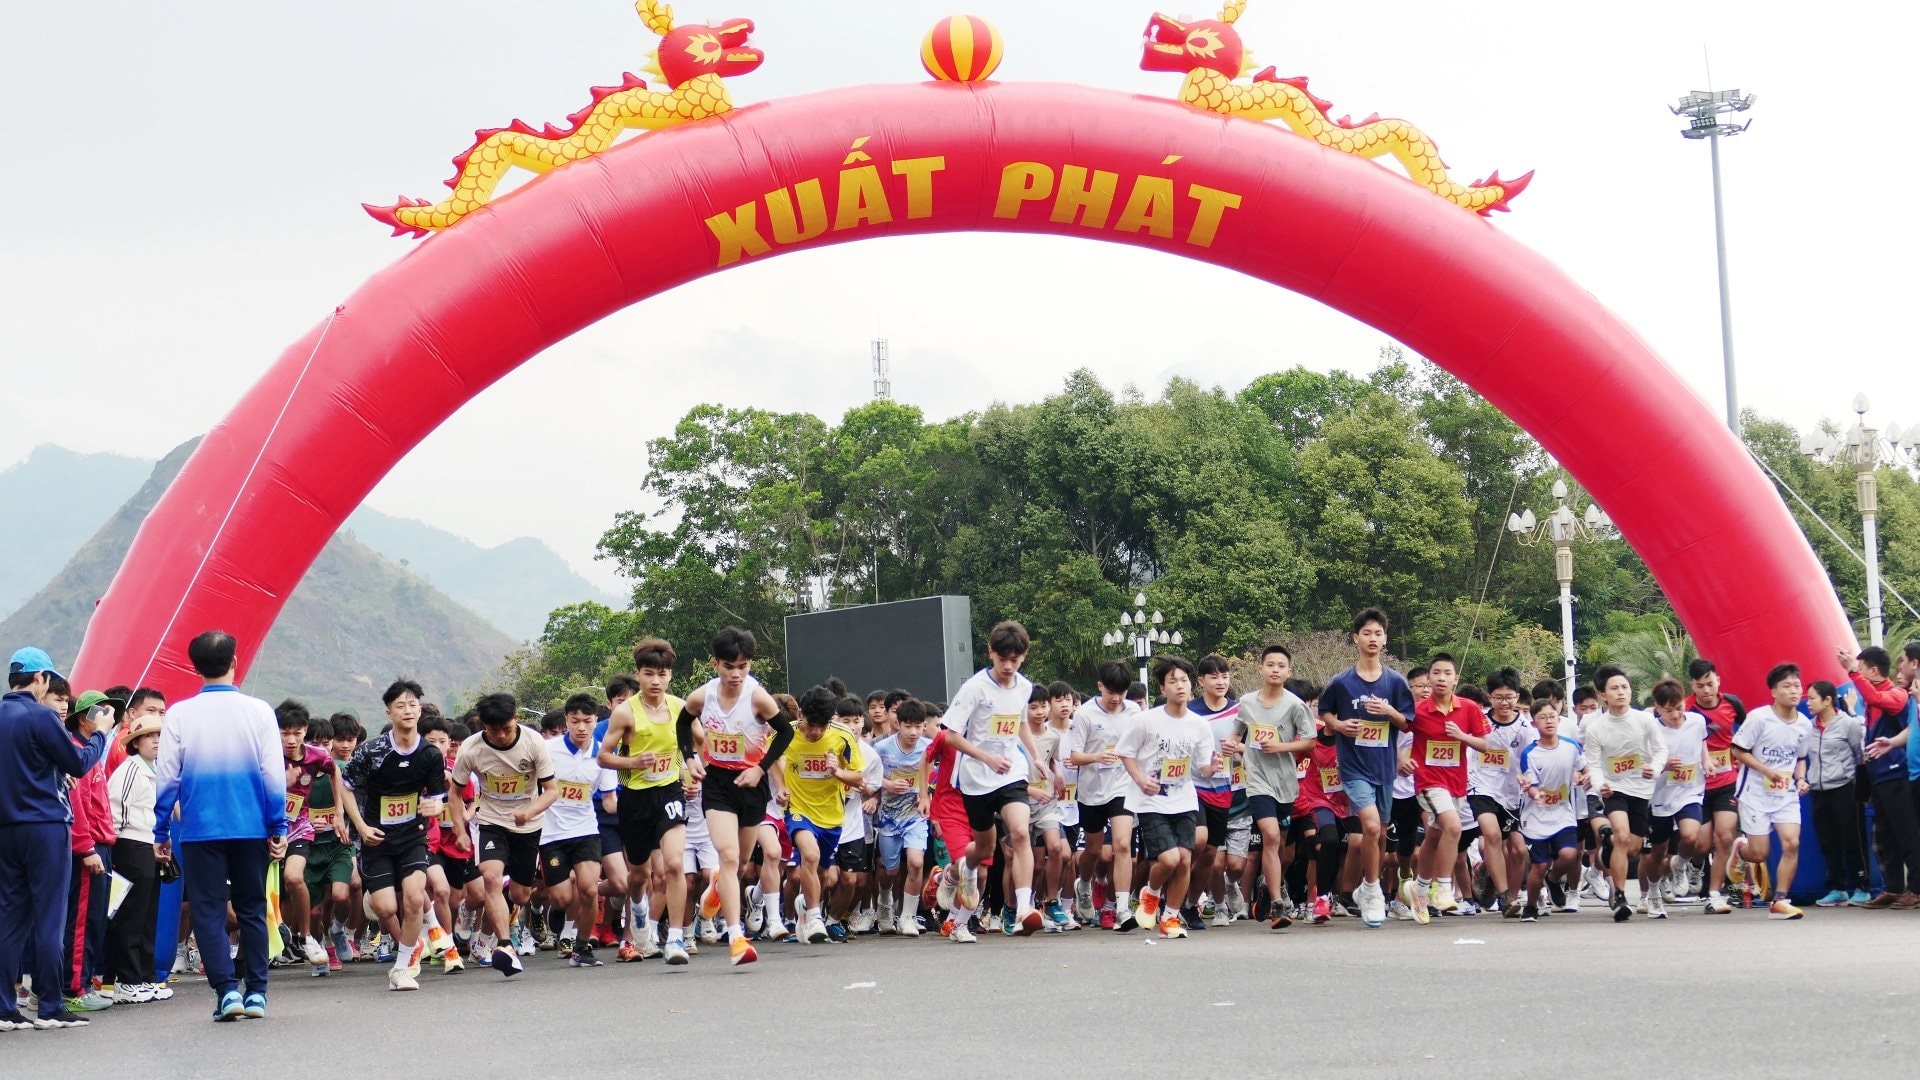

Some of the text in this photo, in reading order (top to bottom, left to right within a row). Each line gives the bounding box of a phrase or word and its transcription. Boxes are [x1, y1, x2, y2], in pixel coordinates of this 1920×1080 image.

[704, 136, 1242, 268] XUẤT PHÁT
[996, 721, 1015, 735] 142
[1363, 727, 1382, 740] 221
[713, 739, 737, 753] 133
[1432, 747, 1454, 760] 229
[1483, 752, 1505, 766] 245
[652, 757, 672, 773] 137
[804, 759, 828, 772] 368
[1613, 759, 1635, 774] 352
[1673, 769, 1693, 782] 347
[494, 781, 518, 794] 127
[561, 786, 584, 801] 124
[388, 800, 410, 817] 331
